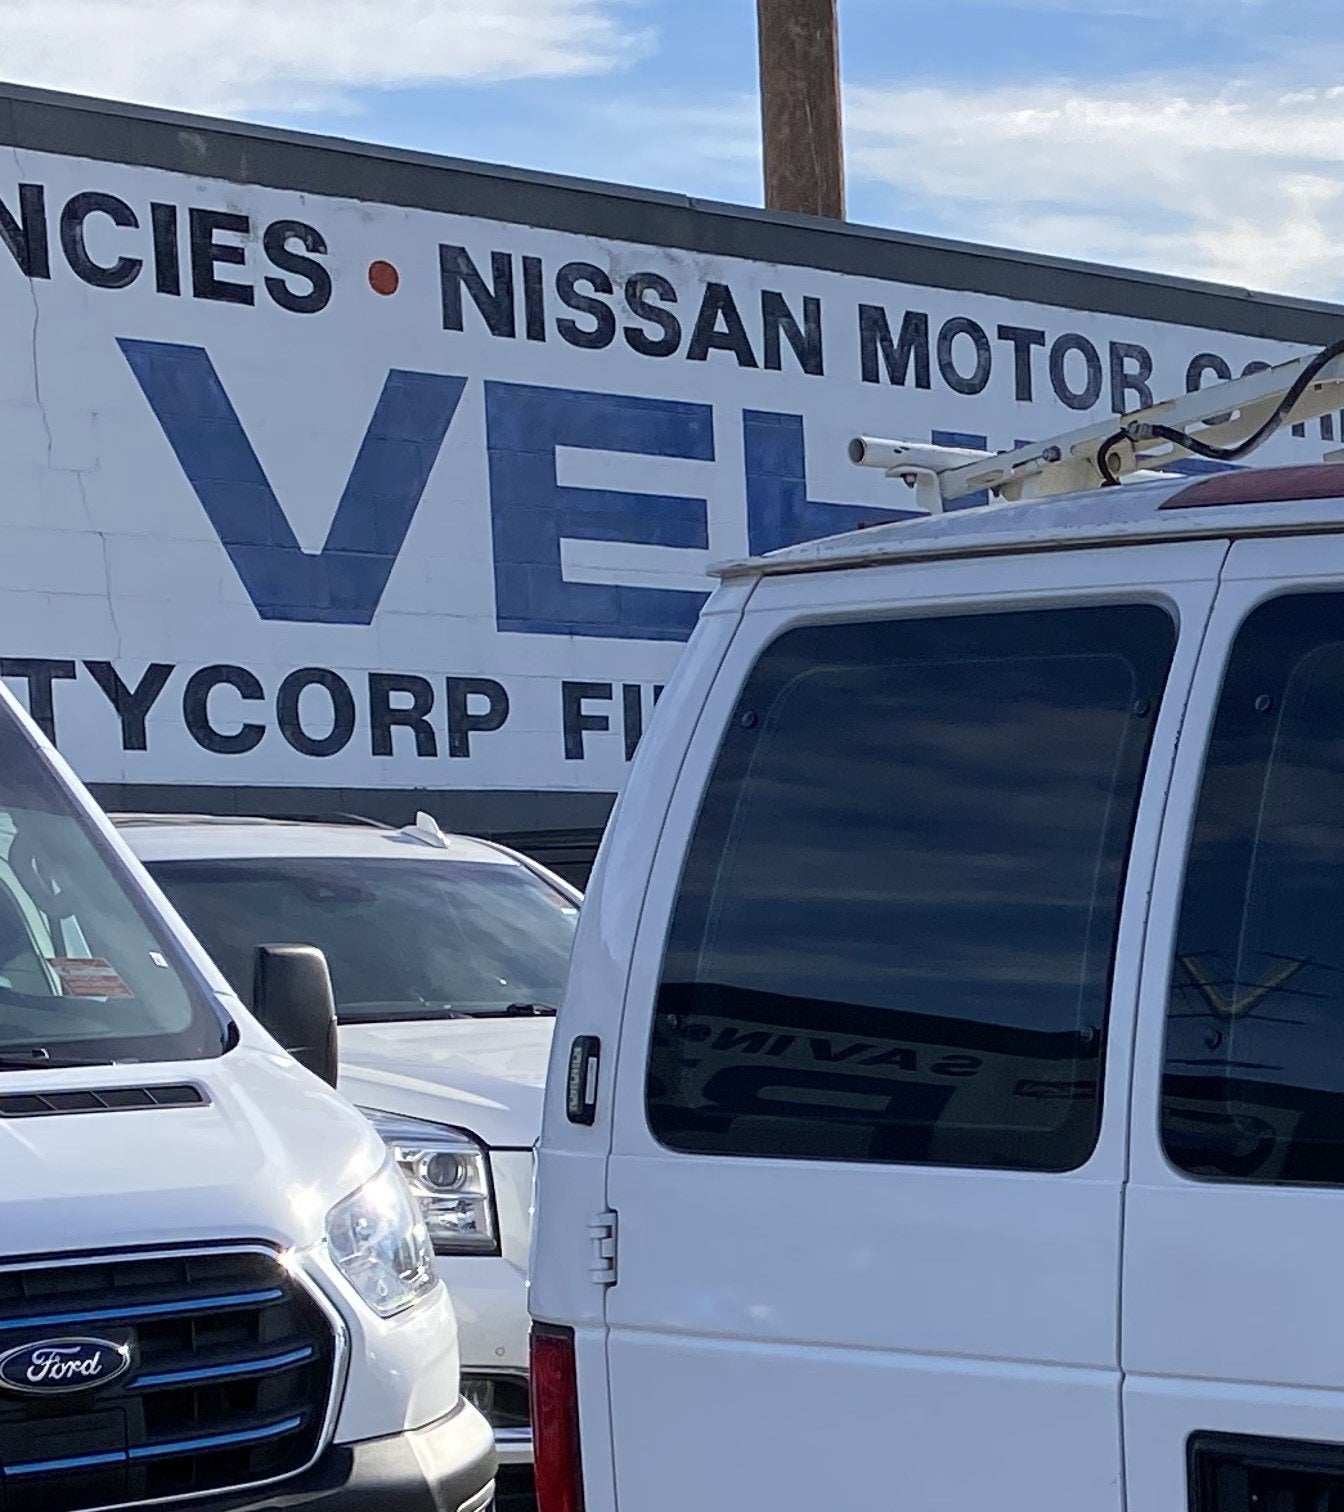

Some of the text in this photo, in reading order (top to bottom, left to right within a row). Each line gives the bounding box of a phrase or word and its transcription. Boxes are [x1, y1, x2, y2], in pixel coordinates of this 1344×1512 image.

[0, 183, 333, 314] NCIES
[438, 243, 825, 377] NISSAN
[858, 302, 1154, 416] MOTOR
[115, 336, 1000, 642] VEH
[0, 657, 510, 759] TYCORP
[26, 1347, 103, 1383] Ford
